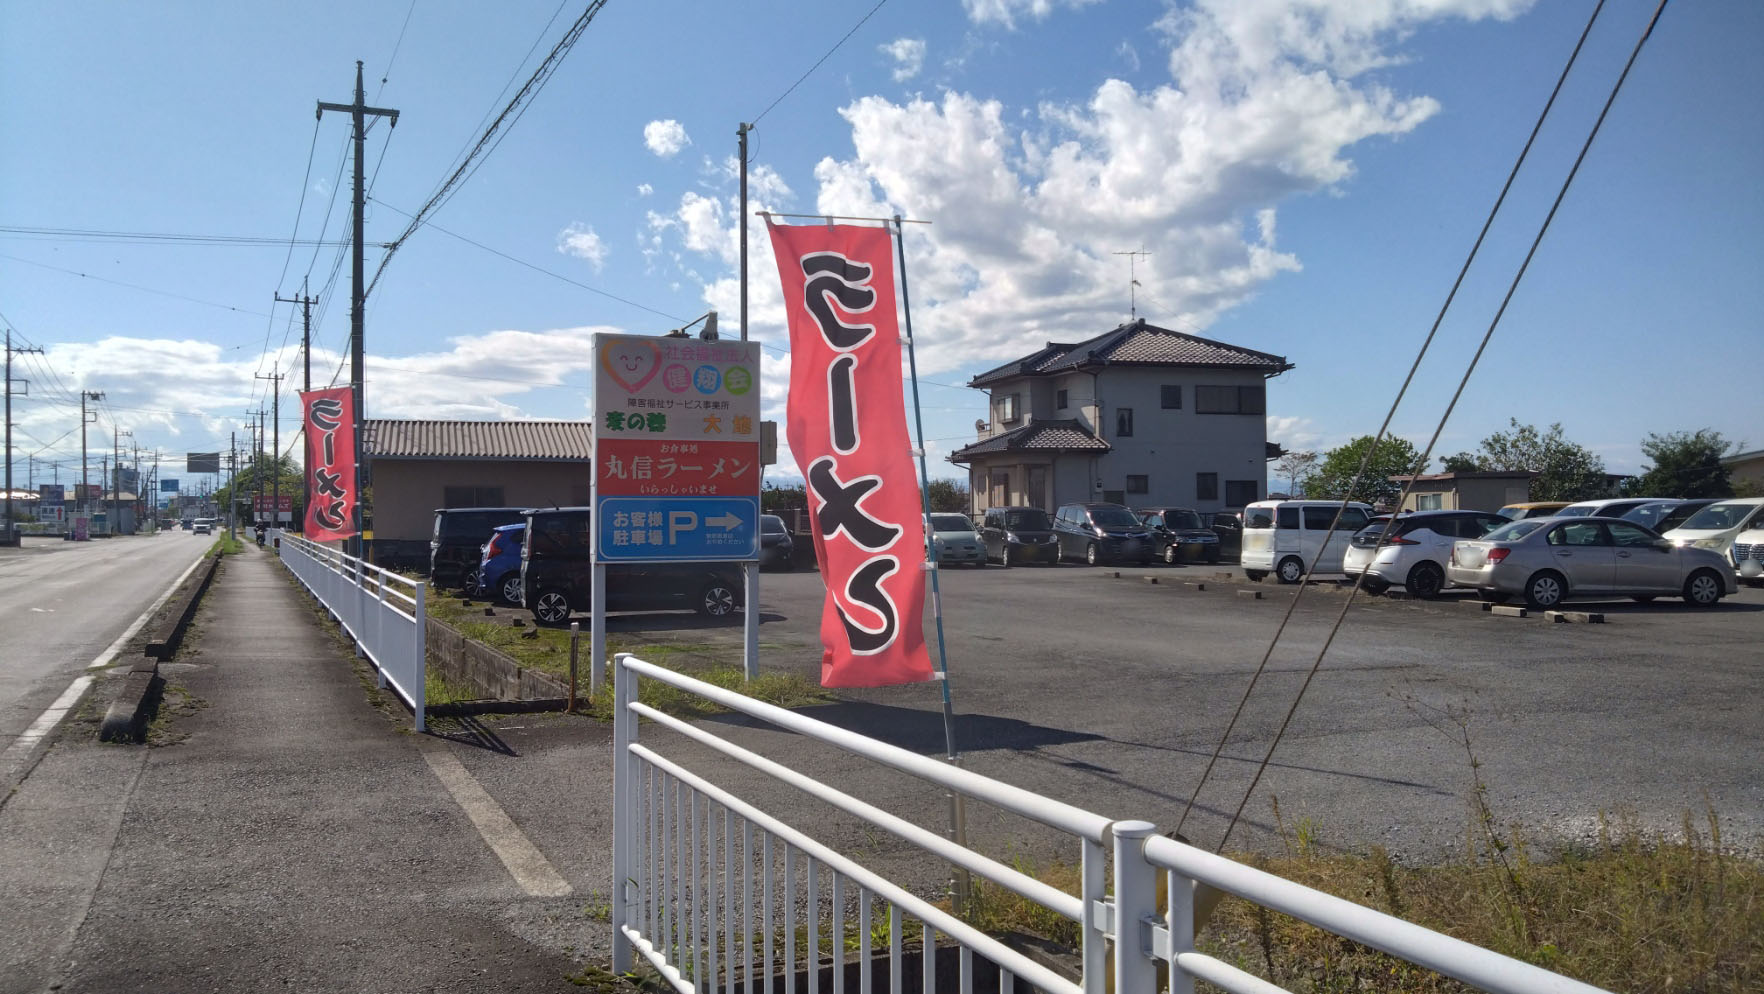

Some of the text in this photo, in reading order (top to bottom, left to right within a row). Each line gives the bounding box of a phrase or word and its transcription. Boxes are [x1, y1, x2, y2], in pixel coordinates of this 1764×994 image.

[627, 398, 730, 411] 障害福祉サービス事業所
[604, 455, 752, 480] 丸信ラーメン
[640, 484, 719, 495] いらっしゃいませ
[613, 511, 663, 528] お客様
[669, 511, 698, 545] P
[613, 530, 663, 546] 駐車場
